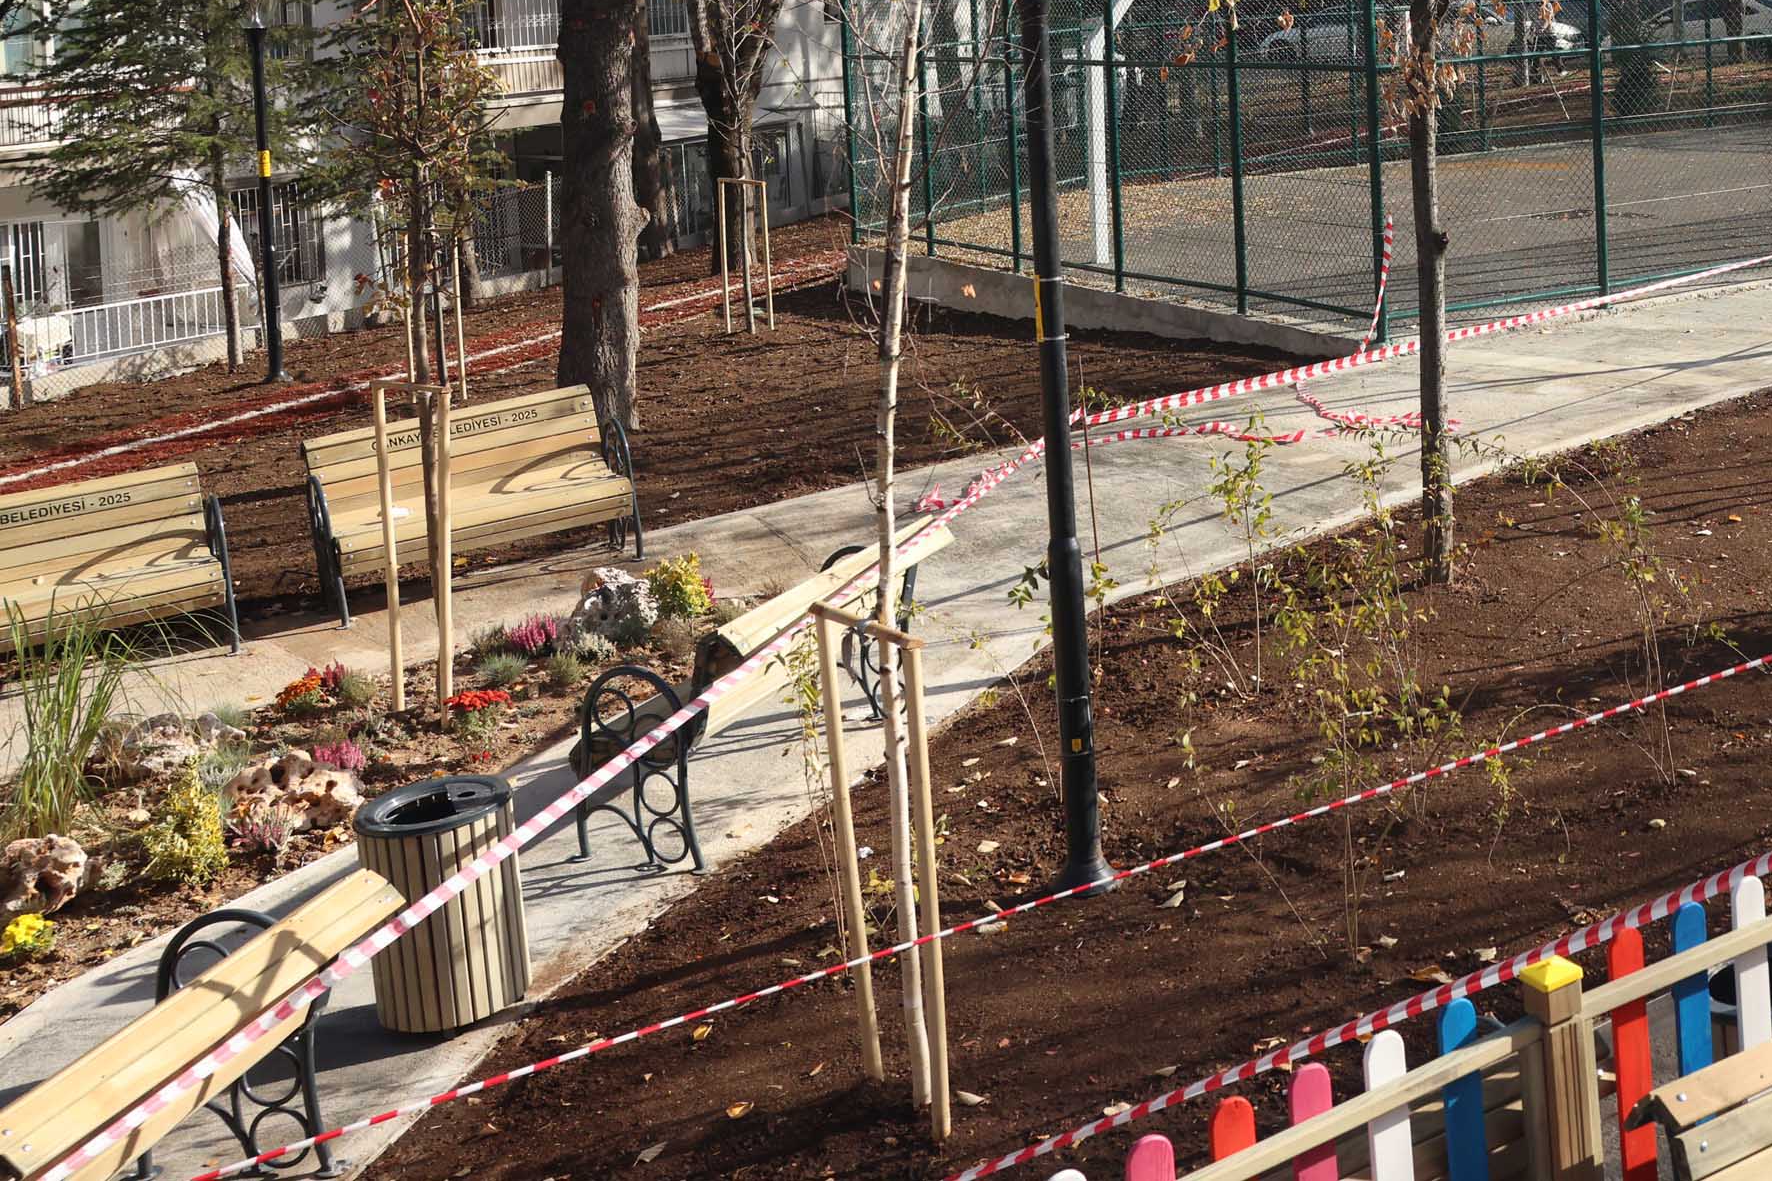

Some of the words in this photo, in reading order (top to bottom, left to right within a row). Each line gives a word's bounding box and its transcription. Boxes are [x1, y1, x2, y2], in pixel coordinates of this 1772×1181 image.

[449, 413, 501, 435] LEDİYESİ
[511, 409, 538, 423] 2025
[0, 497, 86, 525] BELEDİYESİ
[98, 492, 132, 507] 2025
